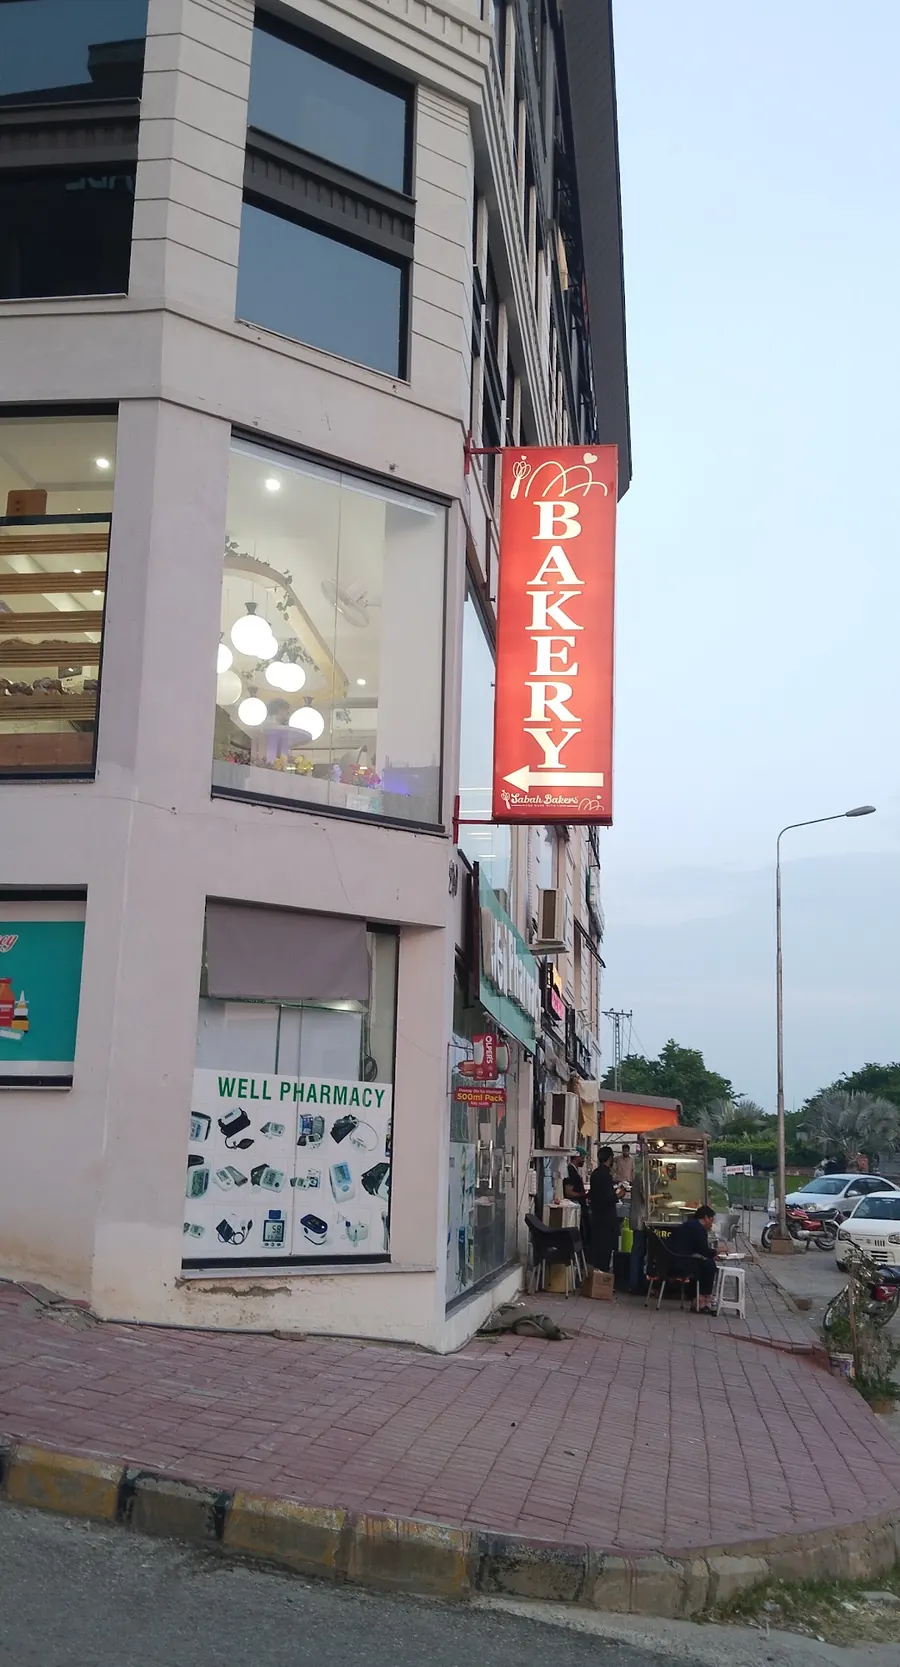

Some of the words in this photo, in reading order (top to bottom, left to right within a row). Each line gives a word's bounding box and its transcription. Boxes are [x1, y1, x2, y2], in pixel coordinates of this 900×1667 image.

[522, 500, 585, 769] BAKERY
[511, 793, 542, 804] Sabah
[218, 1076, 272, 1100] WELL
[280, 1081, 386, 1108] PHARMACY
[457, 1093, 483, 1101] 500ml
[485, 1094, 503, 1102] Pack
